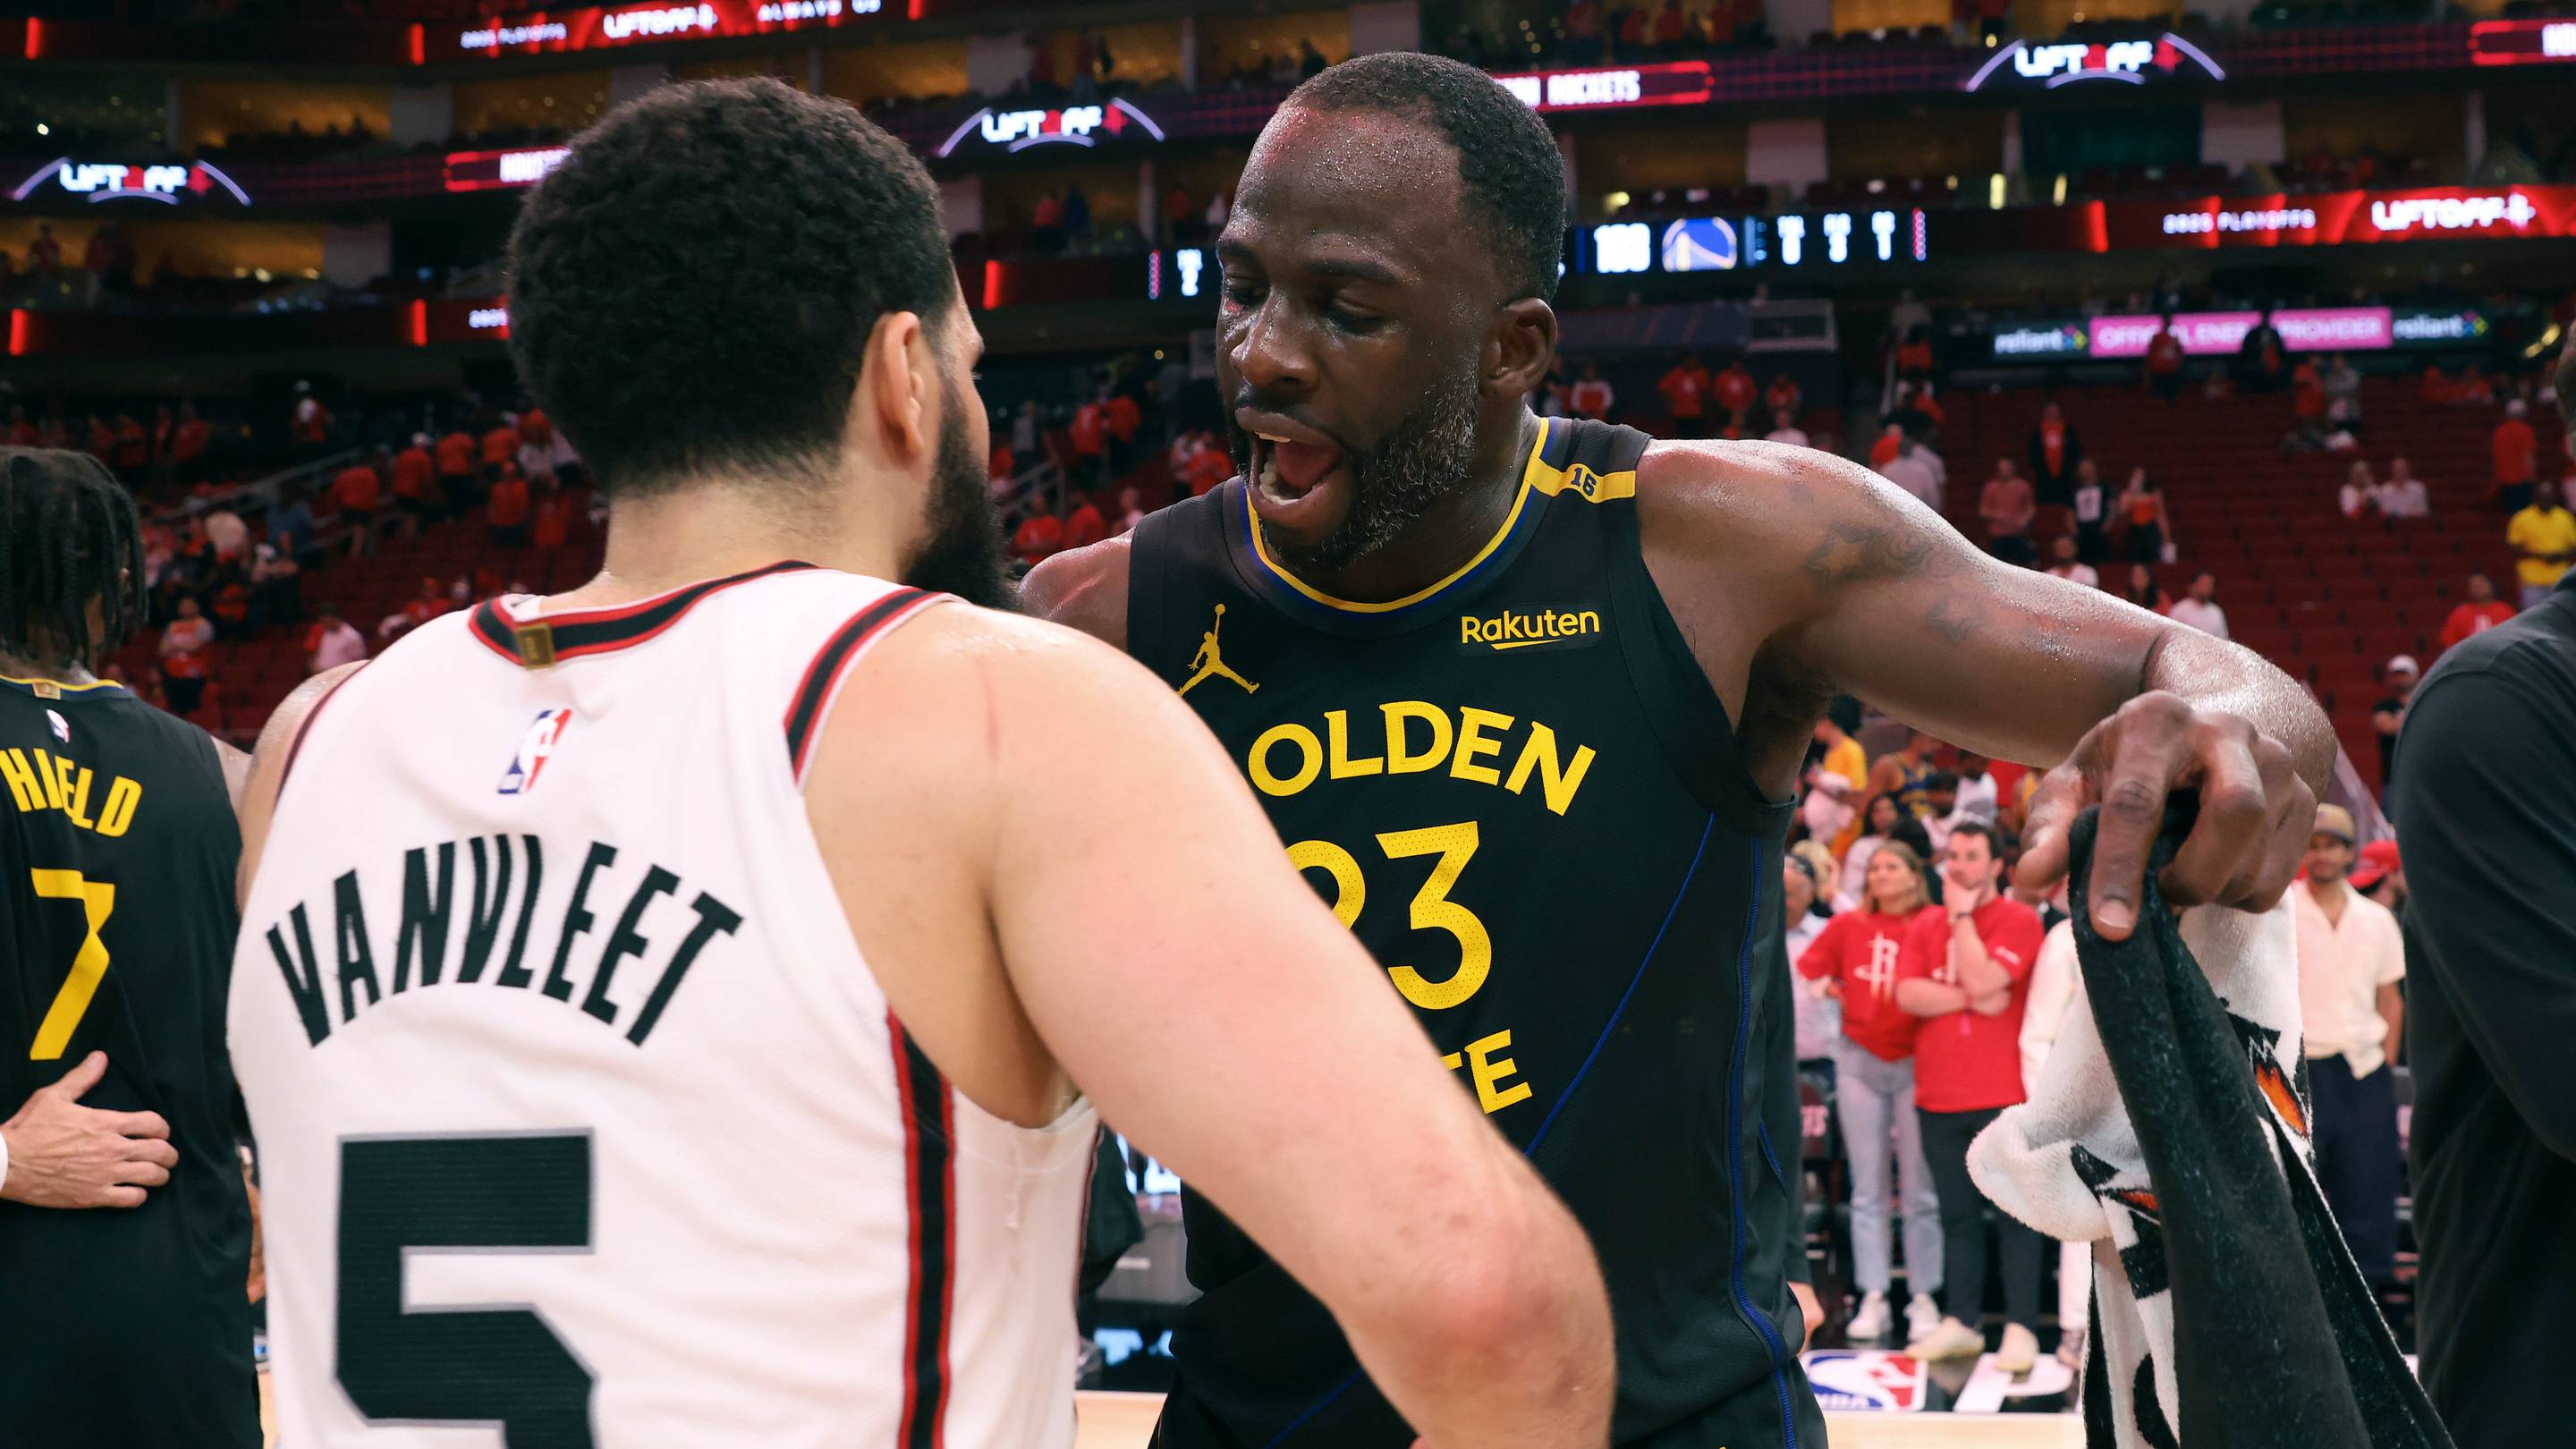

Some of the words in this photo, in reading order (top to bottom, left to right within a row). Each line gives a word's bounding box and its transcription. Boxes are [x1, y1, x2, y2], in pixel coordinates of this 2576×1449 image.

[1571, 467, 1597, 496] 16
[1462, 609, 1600, 644] Rakuten
[0, 747, 143, 837] HIELD
[1248, 700, 1597, 816] OLDEN
[30, 867, 115, 1061] 7
[266, 834, 745, 1046] VANVLEET
[335, 1127, 599, 1449] 5
